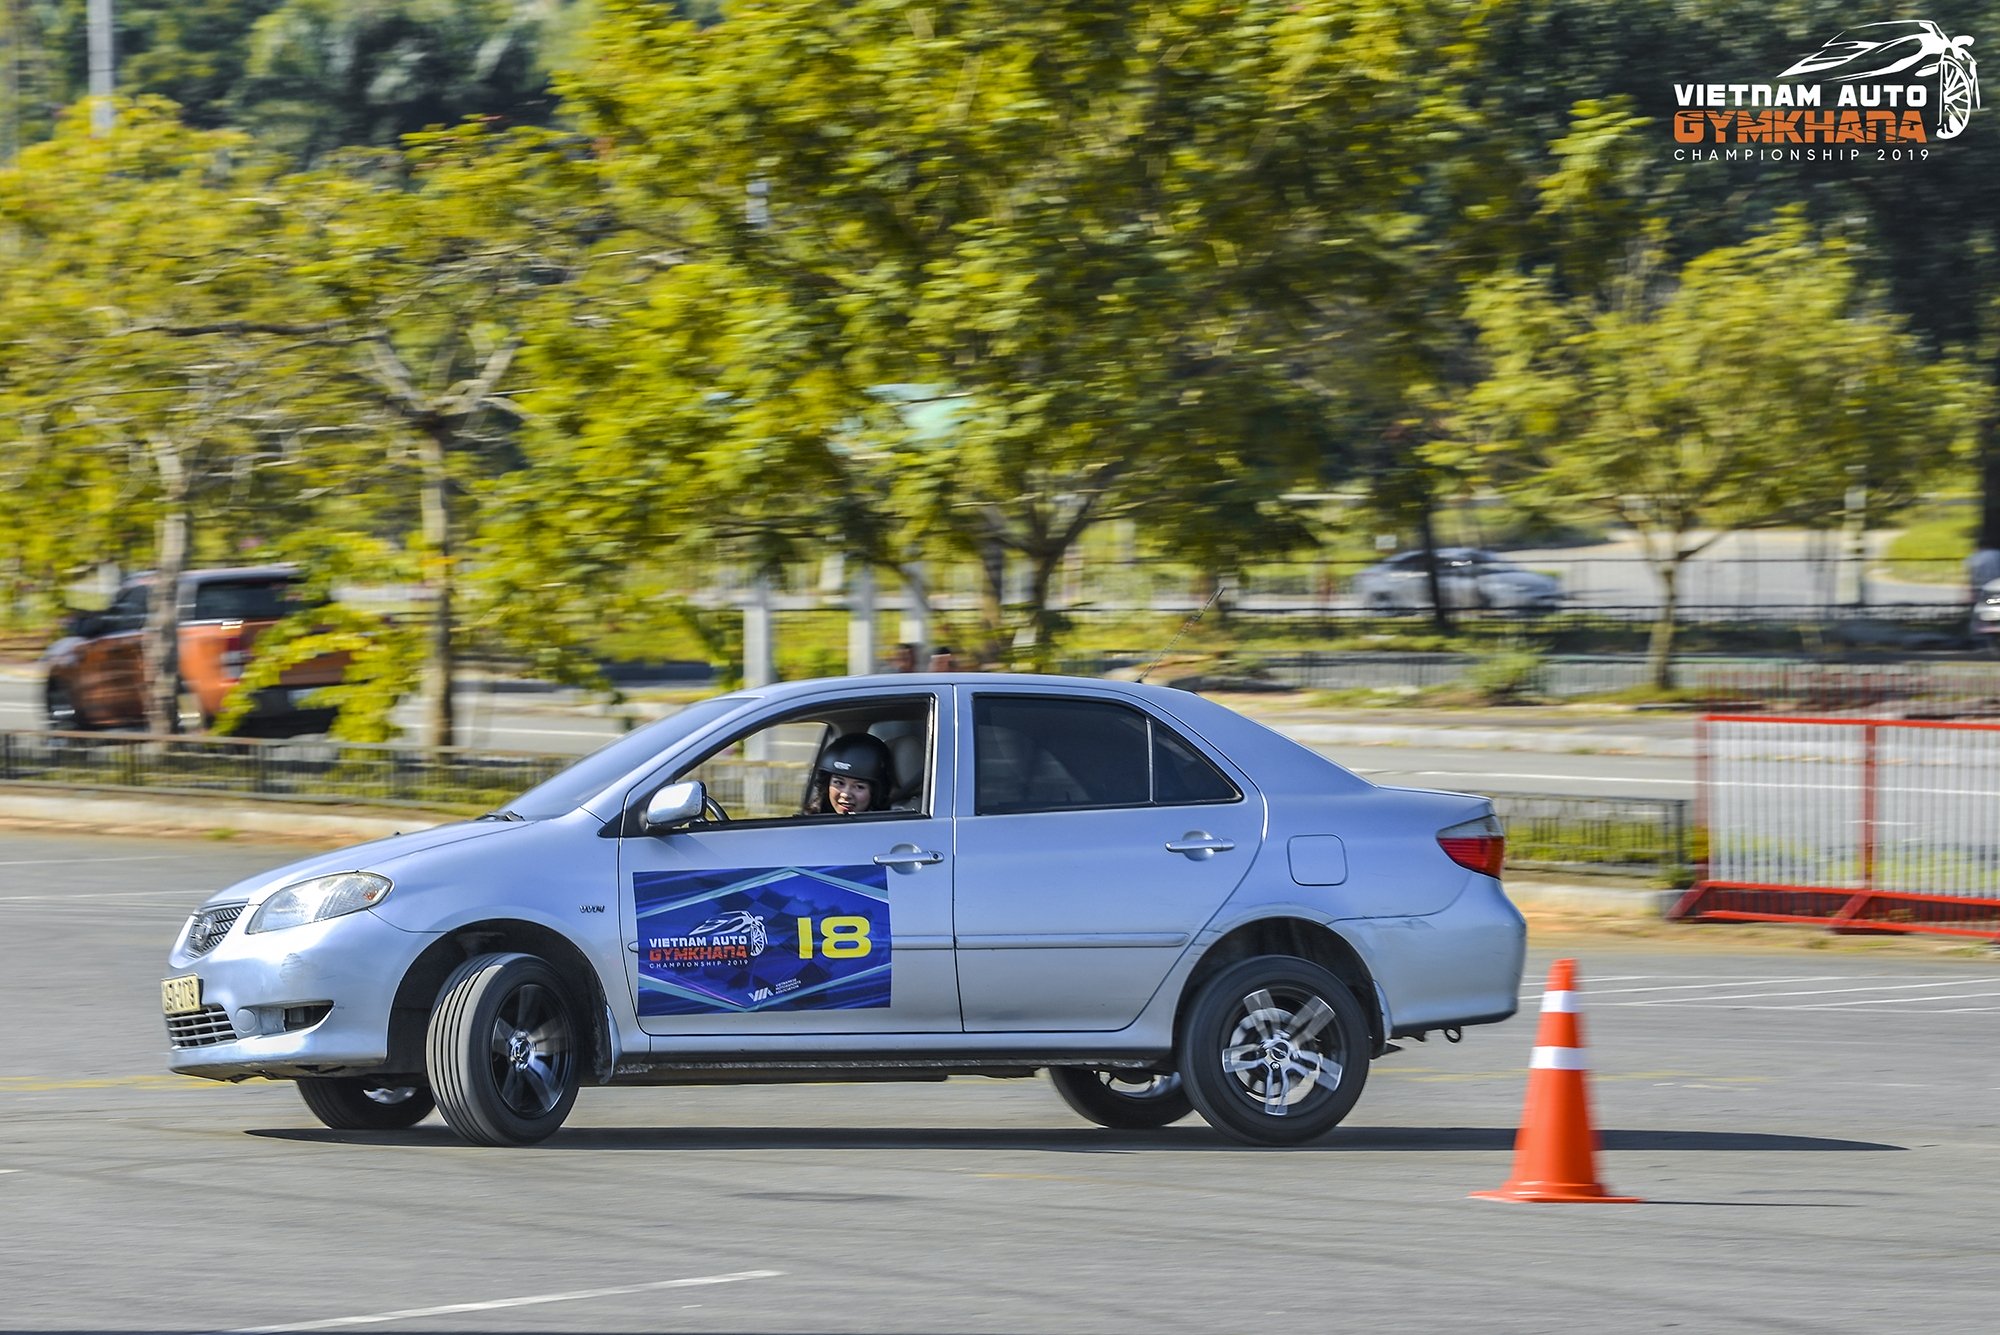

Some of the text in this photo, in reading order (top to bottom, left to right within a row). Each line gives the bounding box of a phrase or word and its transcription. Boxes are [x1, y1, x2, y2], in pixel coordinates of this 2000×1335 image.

[649, 935, 748, 948] VIETNAM AUTO
[797, 916, 872, 959] 18
[649, 945, 747, 962] GYMKHANA
[649, 960, 722, 969] CHAMPIONSHIP
